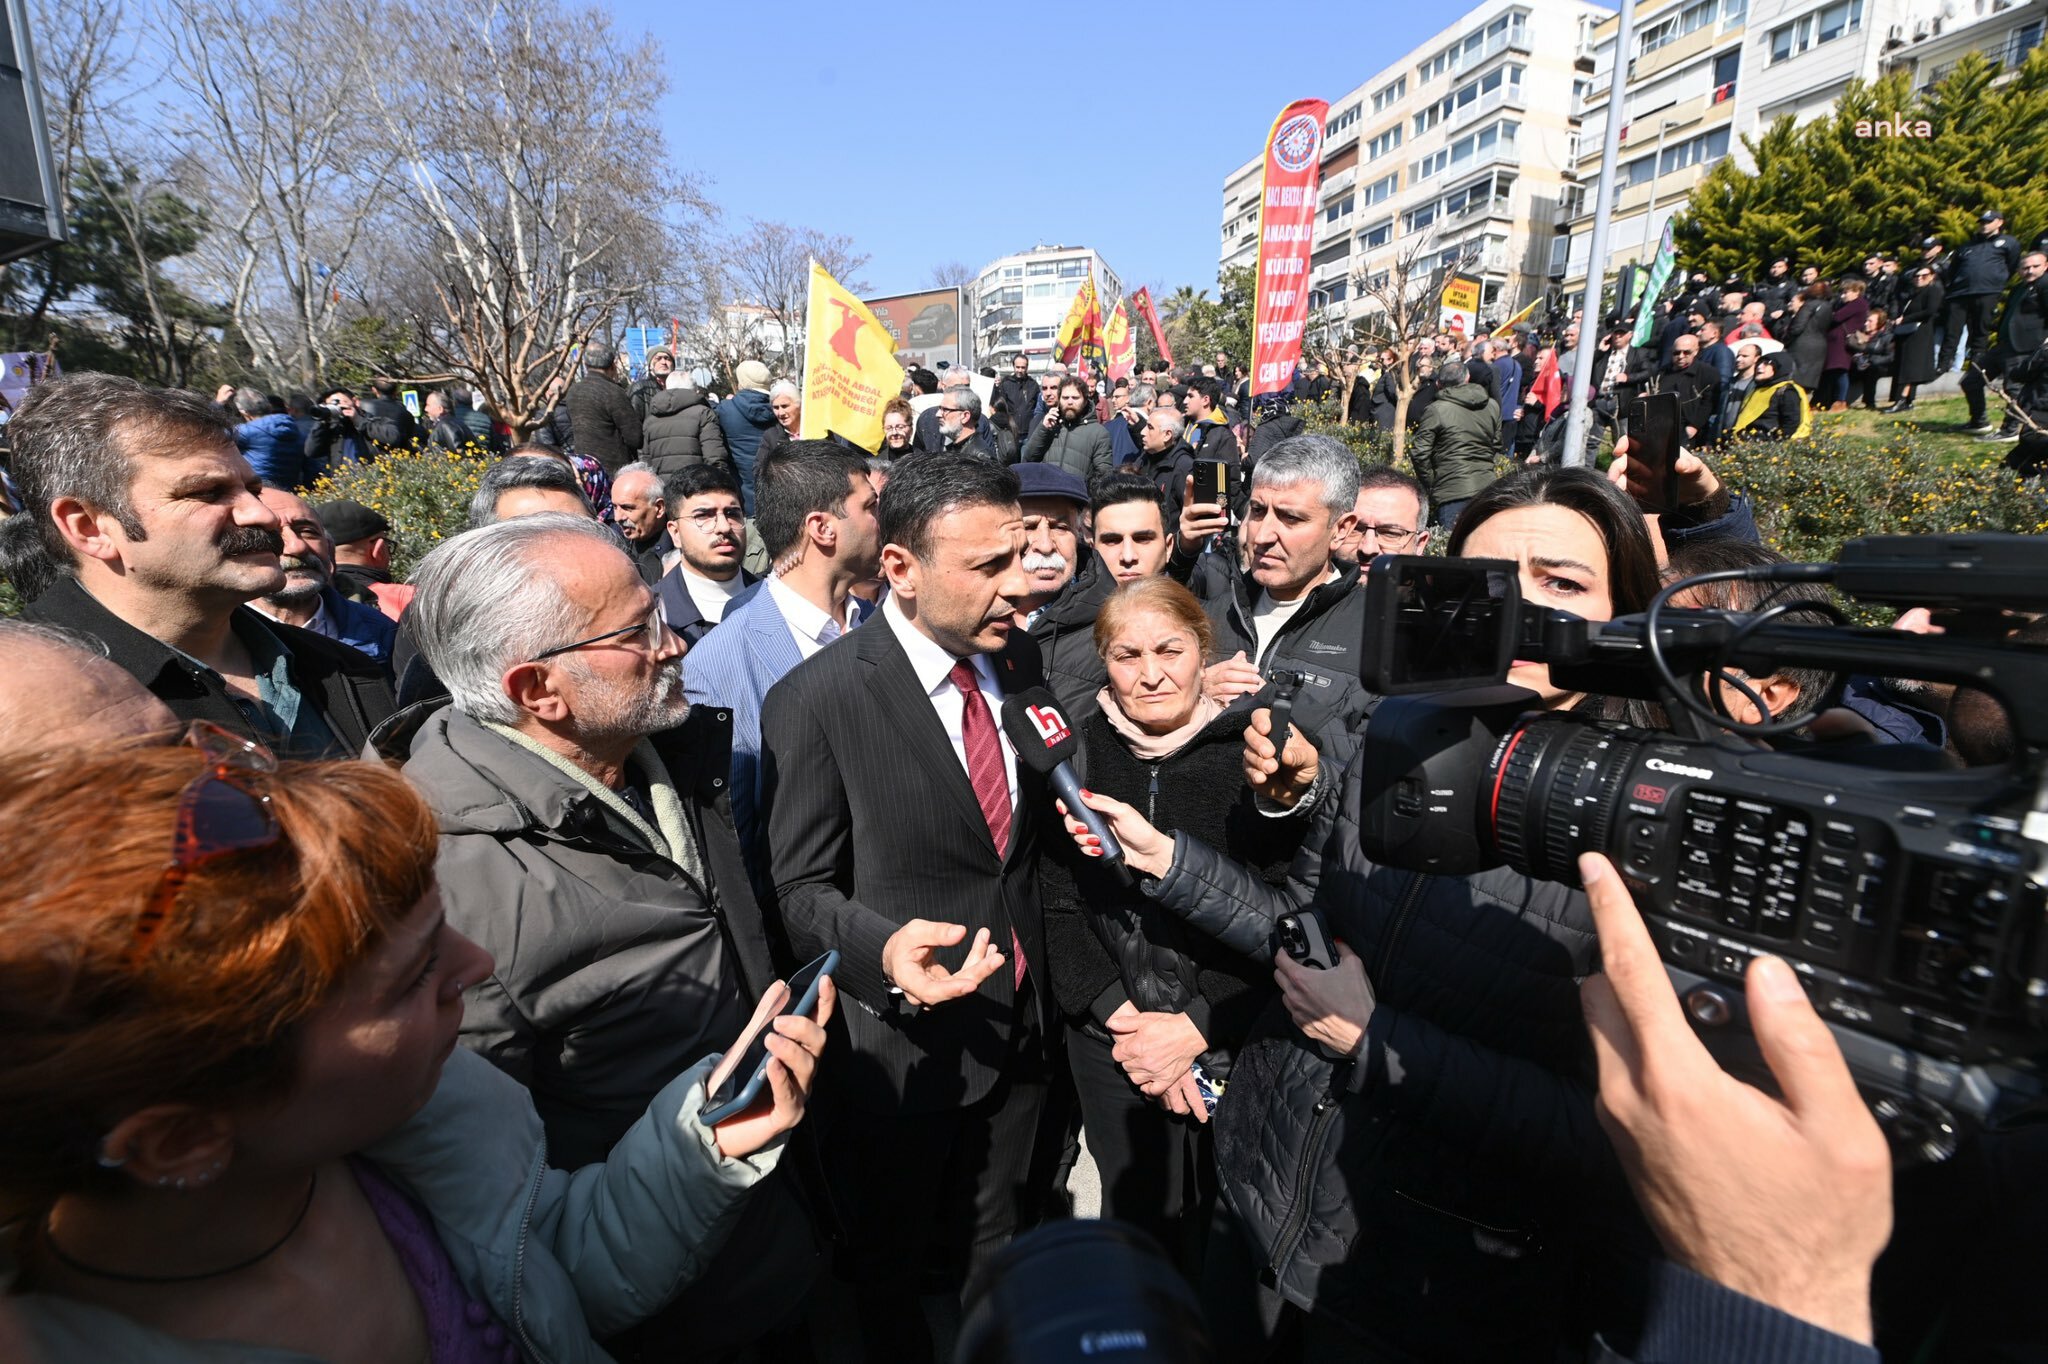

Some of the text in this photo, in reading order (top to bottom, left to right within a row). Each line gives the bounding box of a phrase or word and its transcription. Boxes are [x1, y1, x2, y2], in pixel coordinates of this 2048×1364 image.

[1265, 186, 1281, 207] HACI
[1263, 224, 1312, 242] ANADOLU
[1265, 253, 1304, 276] KÜLTÜR
[1268, 289, 1297, 308] VAKFI
[1258, 316, 1304, 349] YEŞİLKENT
[1259, 353, 1294, 384] CEM EVİ
[851, 381, 882, 398] ABDAL
[1050, 732, 1067, 745] halk
[1645, 758, 1714, 780] Canon
[1081, 1331, 1147, 1355] Canon
